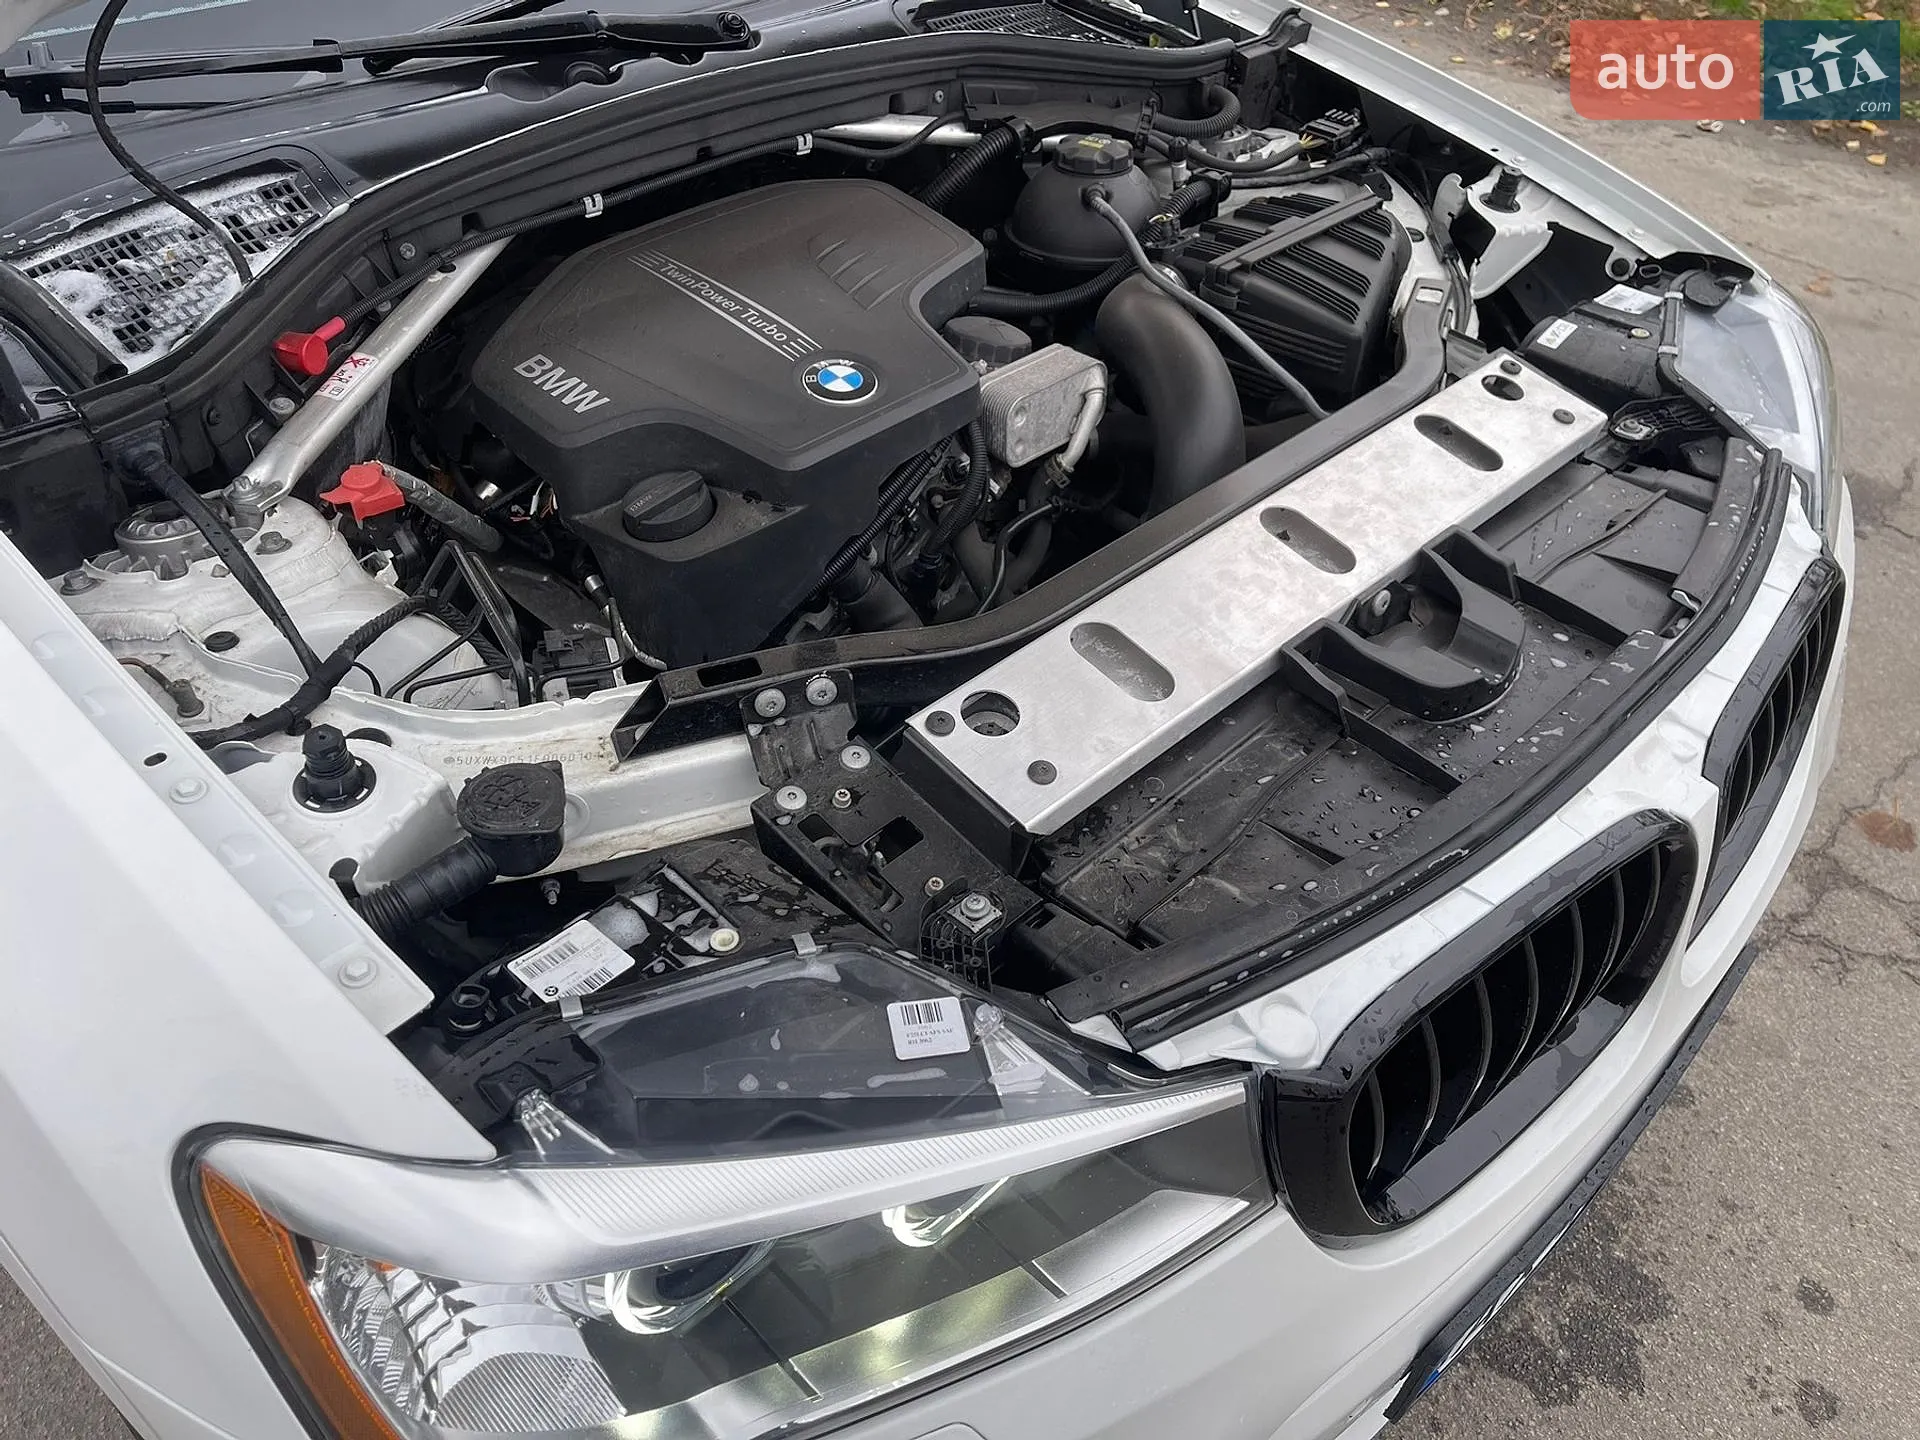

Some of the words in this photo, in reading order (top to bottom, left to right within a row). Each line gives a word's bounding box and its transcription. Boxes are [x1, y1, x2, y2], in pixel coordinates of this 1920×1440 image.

[660, 263, 744, 312] TwinPower
[741, 308, 788, 342] Turbo
[513, 353, 611, 413] BMW
